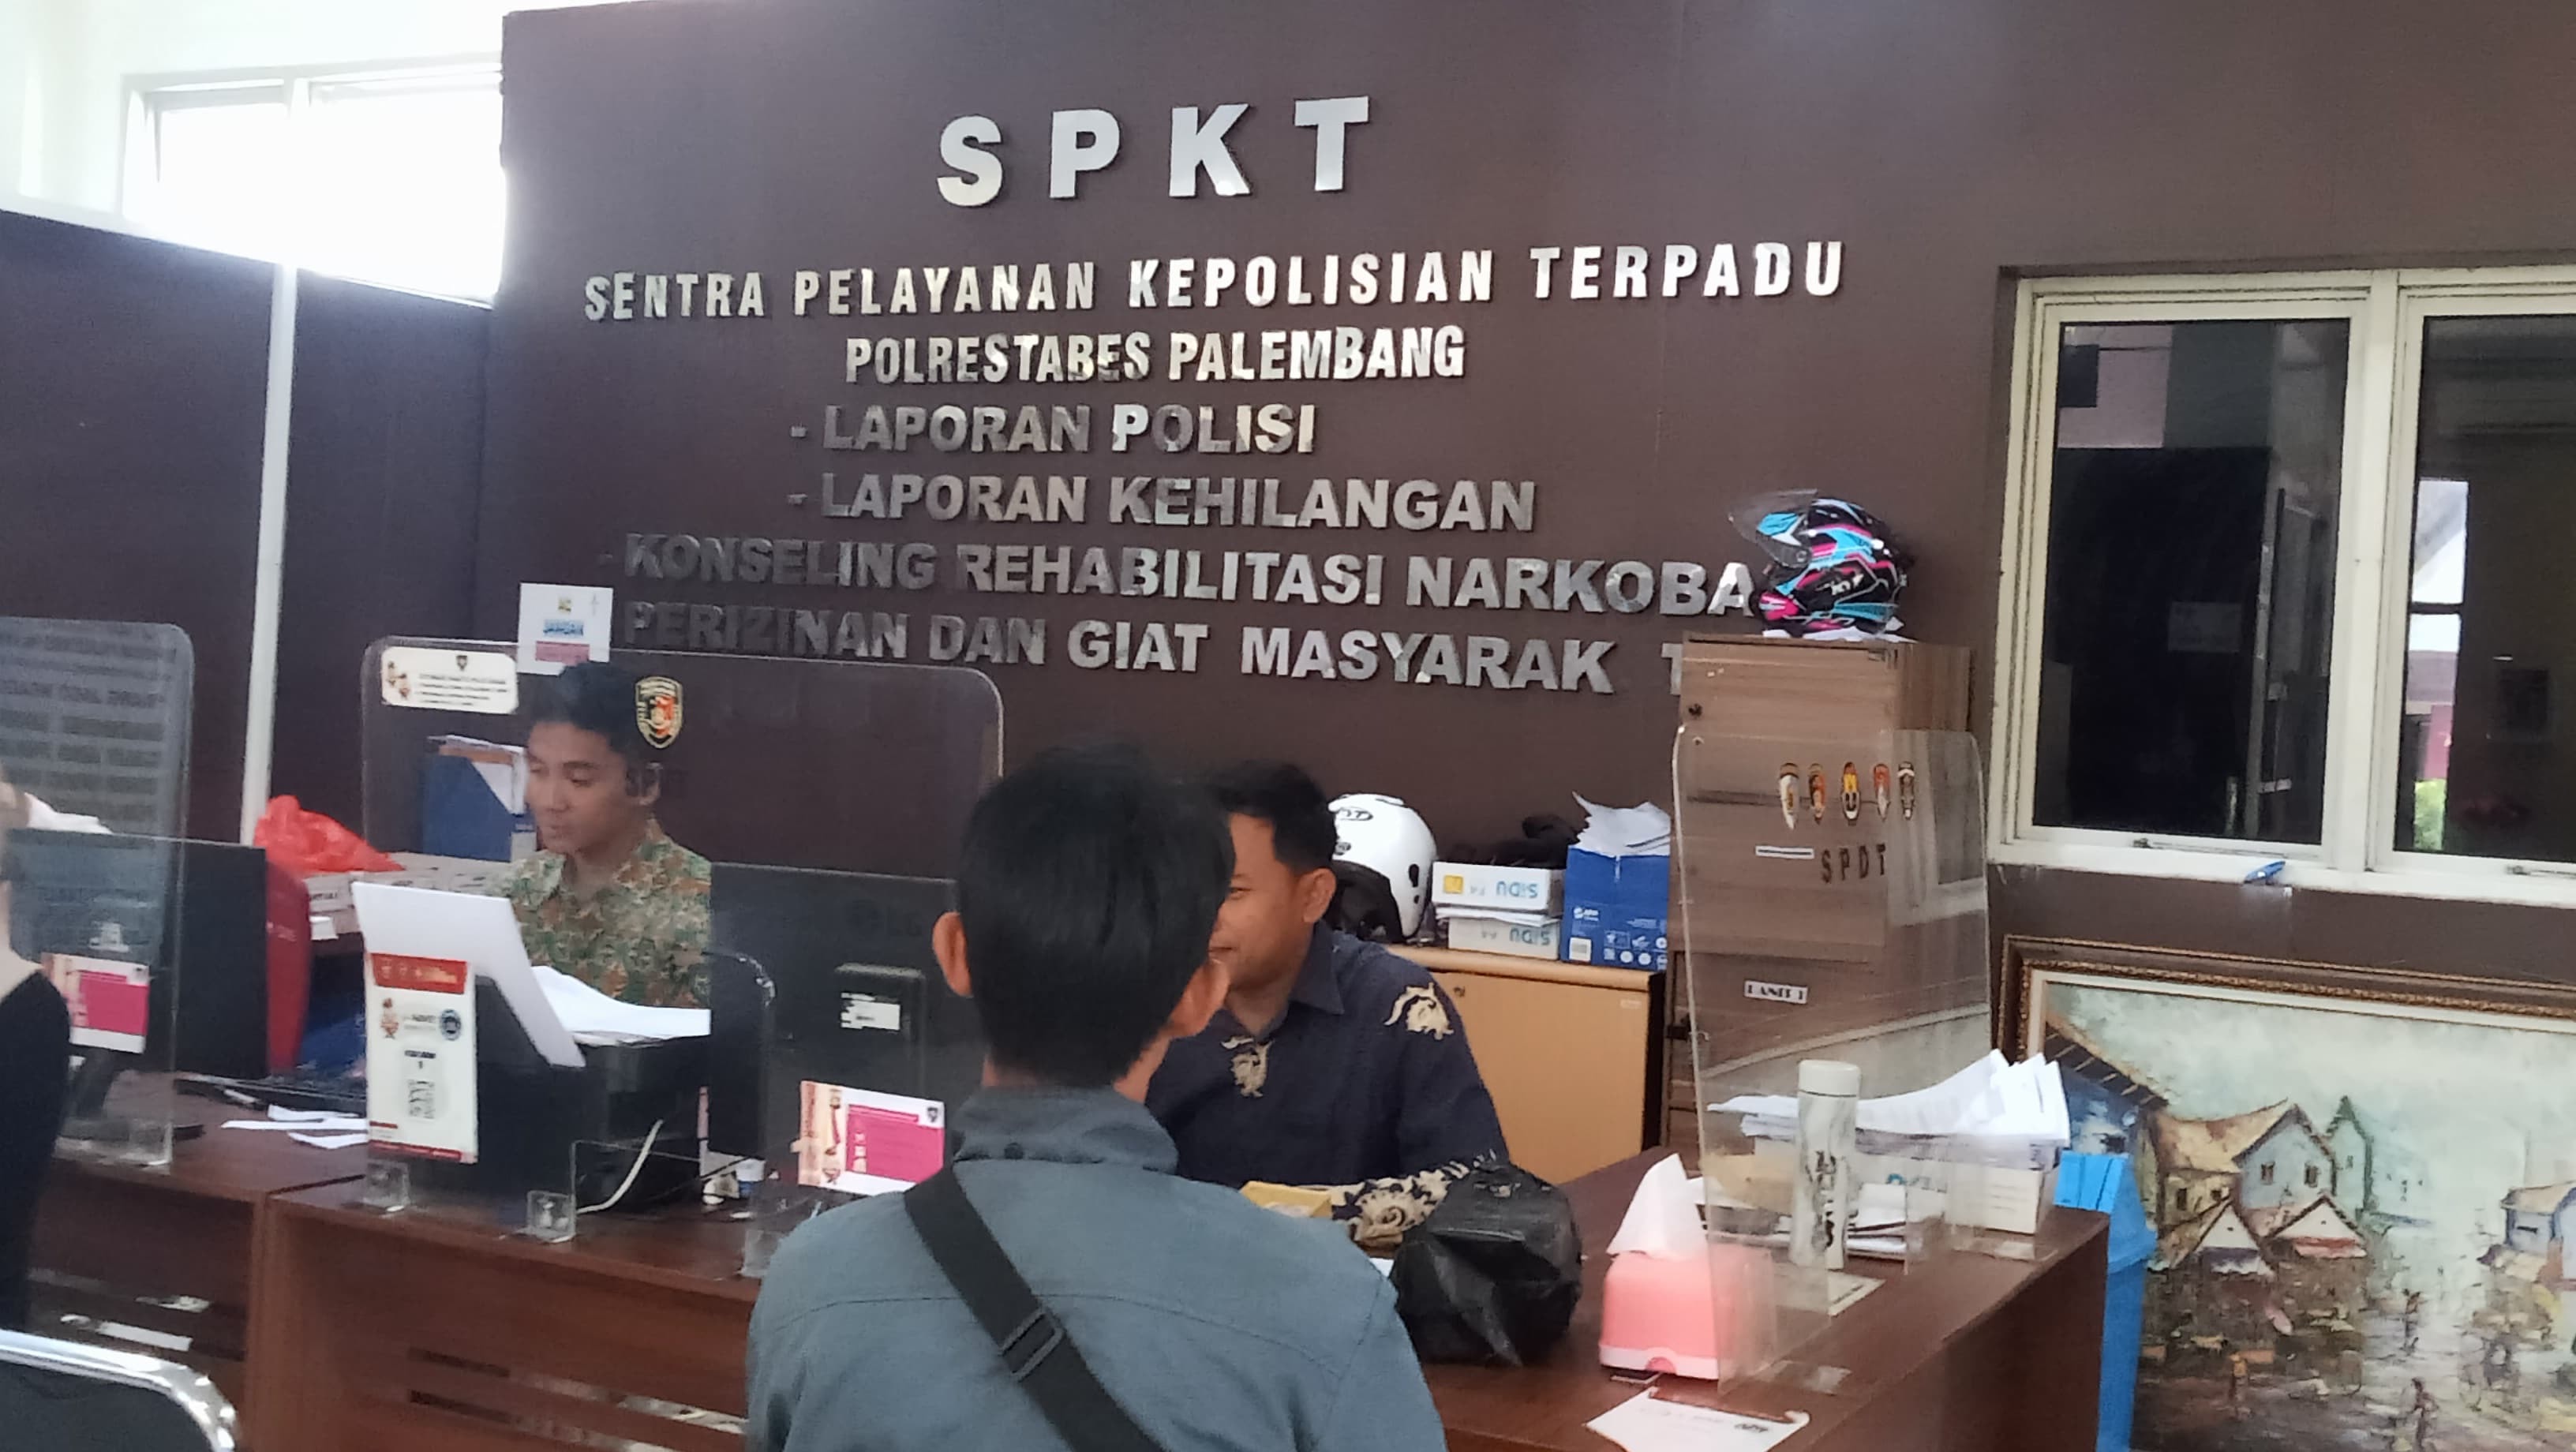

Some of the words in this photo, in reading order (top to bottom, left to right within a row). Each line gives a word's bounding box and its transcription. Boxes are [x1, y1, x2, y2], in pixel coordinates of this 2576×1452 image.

[585, 271, 766, 321] SENTRA
[794, 261, 1095, 317] PELAYANAN
[1129, 249, 1493, 309] KEPOLISIAN
[1530, 241, 1844, 301] TERPADU
[845, 331, 1151, 384] POLRESTABES
[1169, 326, 1466, 383] PALEMBANG
[822, 403, 1091, 454] LAPORAN
[1112, 403, 1316, 455] POLISI
[822, 473, 1088, 523] LAPORAN
[1109, 475, 1537, 532] KEHILANGAN
[624, 533, 937, 590] KONSELING
[957, 544, 1383, 606] REHABILITASI
[1406, 555, 1755, 617] NARKOBA
[624, 601, 908, 660] PERIZINAN
[929, 614, 1047, 666] DAN
[1067, 619, 1209, 673] GIAT
[1241, 626, 1616, 694] MASYARAK
